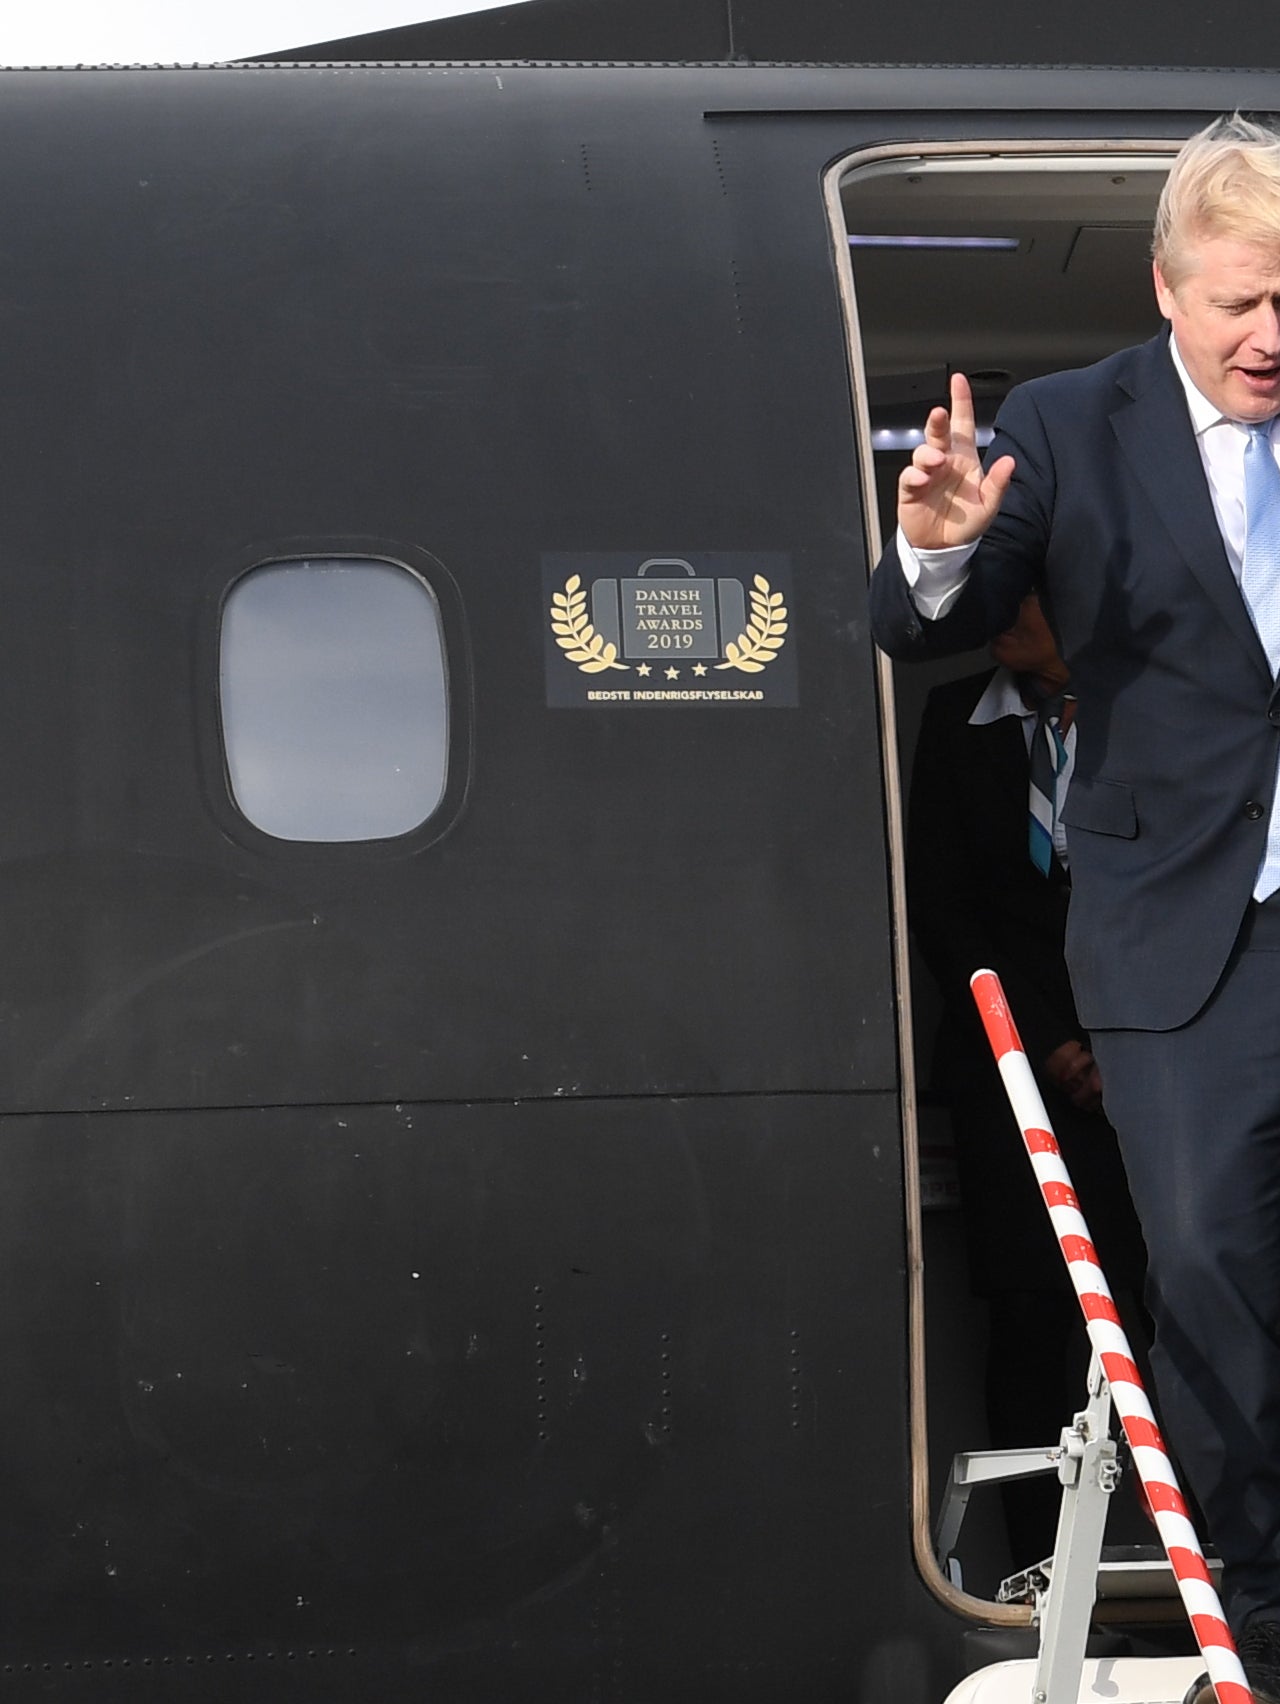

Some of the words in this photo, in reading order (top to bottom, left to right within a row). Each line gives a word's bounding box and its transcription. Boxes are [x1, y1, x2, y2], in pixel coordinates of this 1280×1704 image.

[635, 590, 700, 601] DANISH
[635, 605, 703, 616] TRAVEL
[636, 619, 703, 630] AWARDS
[647, 634, 693, 649] 2019
[587, 691, 631, 700] BEDSTE
[633, 691, 764, 700] INDENRIGSFLYSELSKAB
